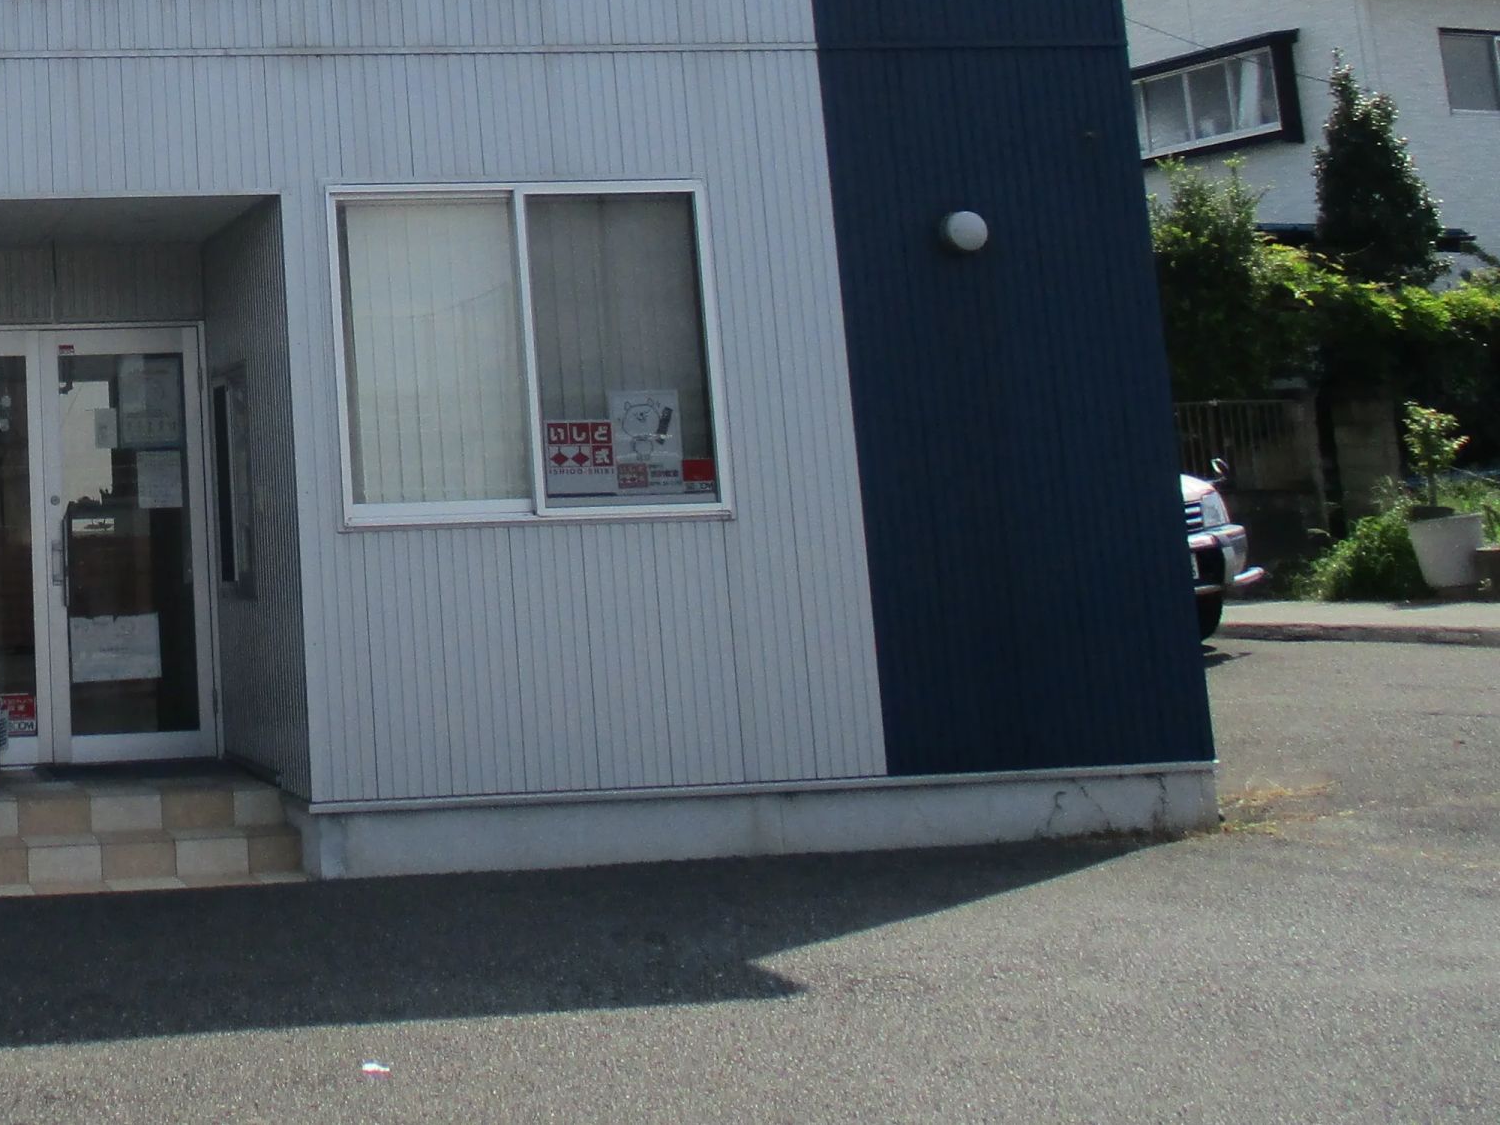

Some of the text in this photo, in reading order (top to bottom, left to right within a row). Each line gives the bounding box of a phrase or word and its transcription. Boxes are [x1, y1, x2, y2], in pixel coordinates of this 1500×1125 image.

[550, 426, 609, 442] いしど
[595, 449, 610, 464] 式
